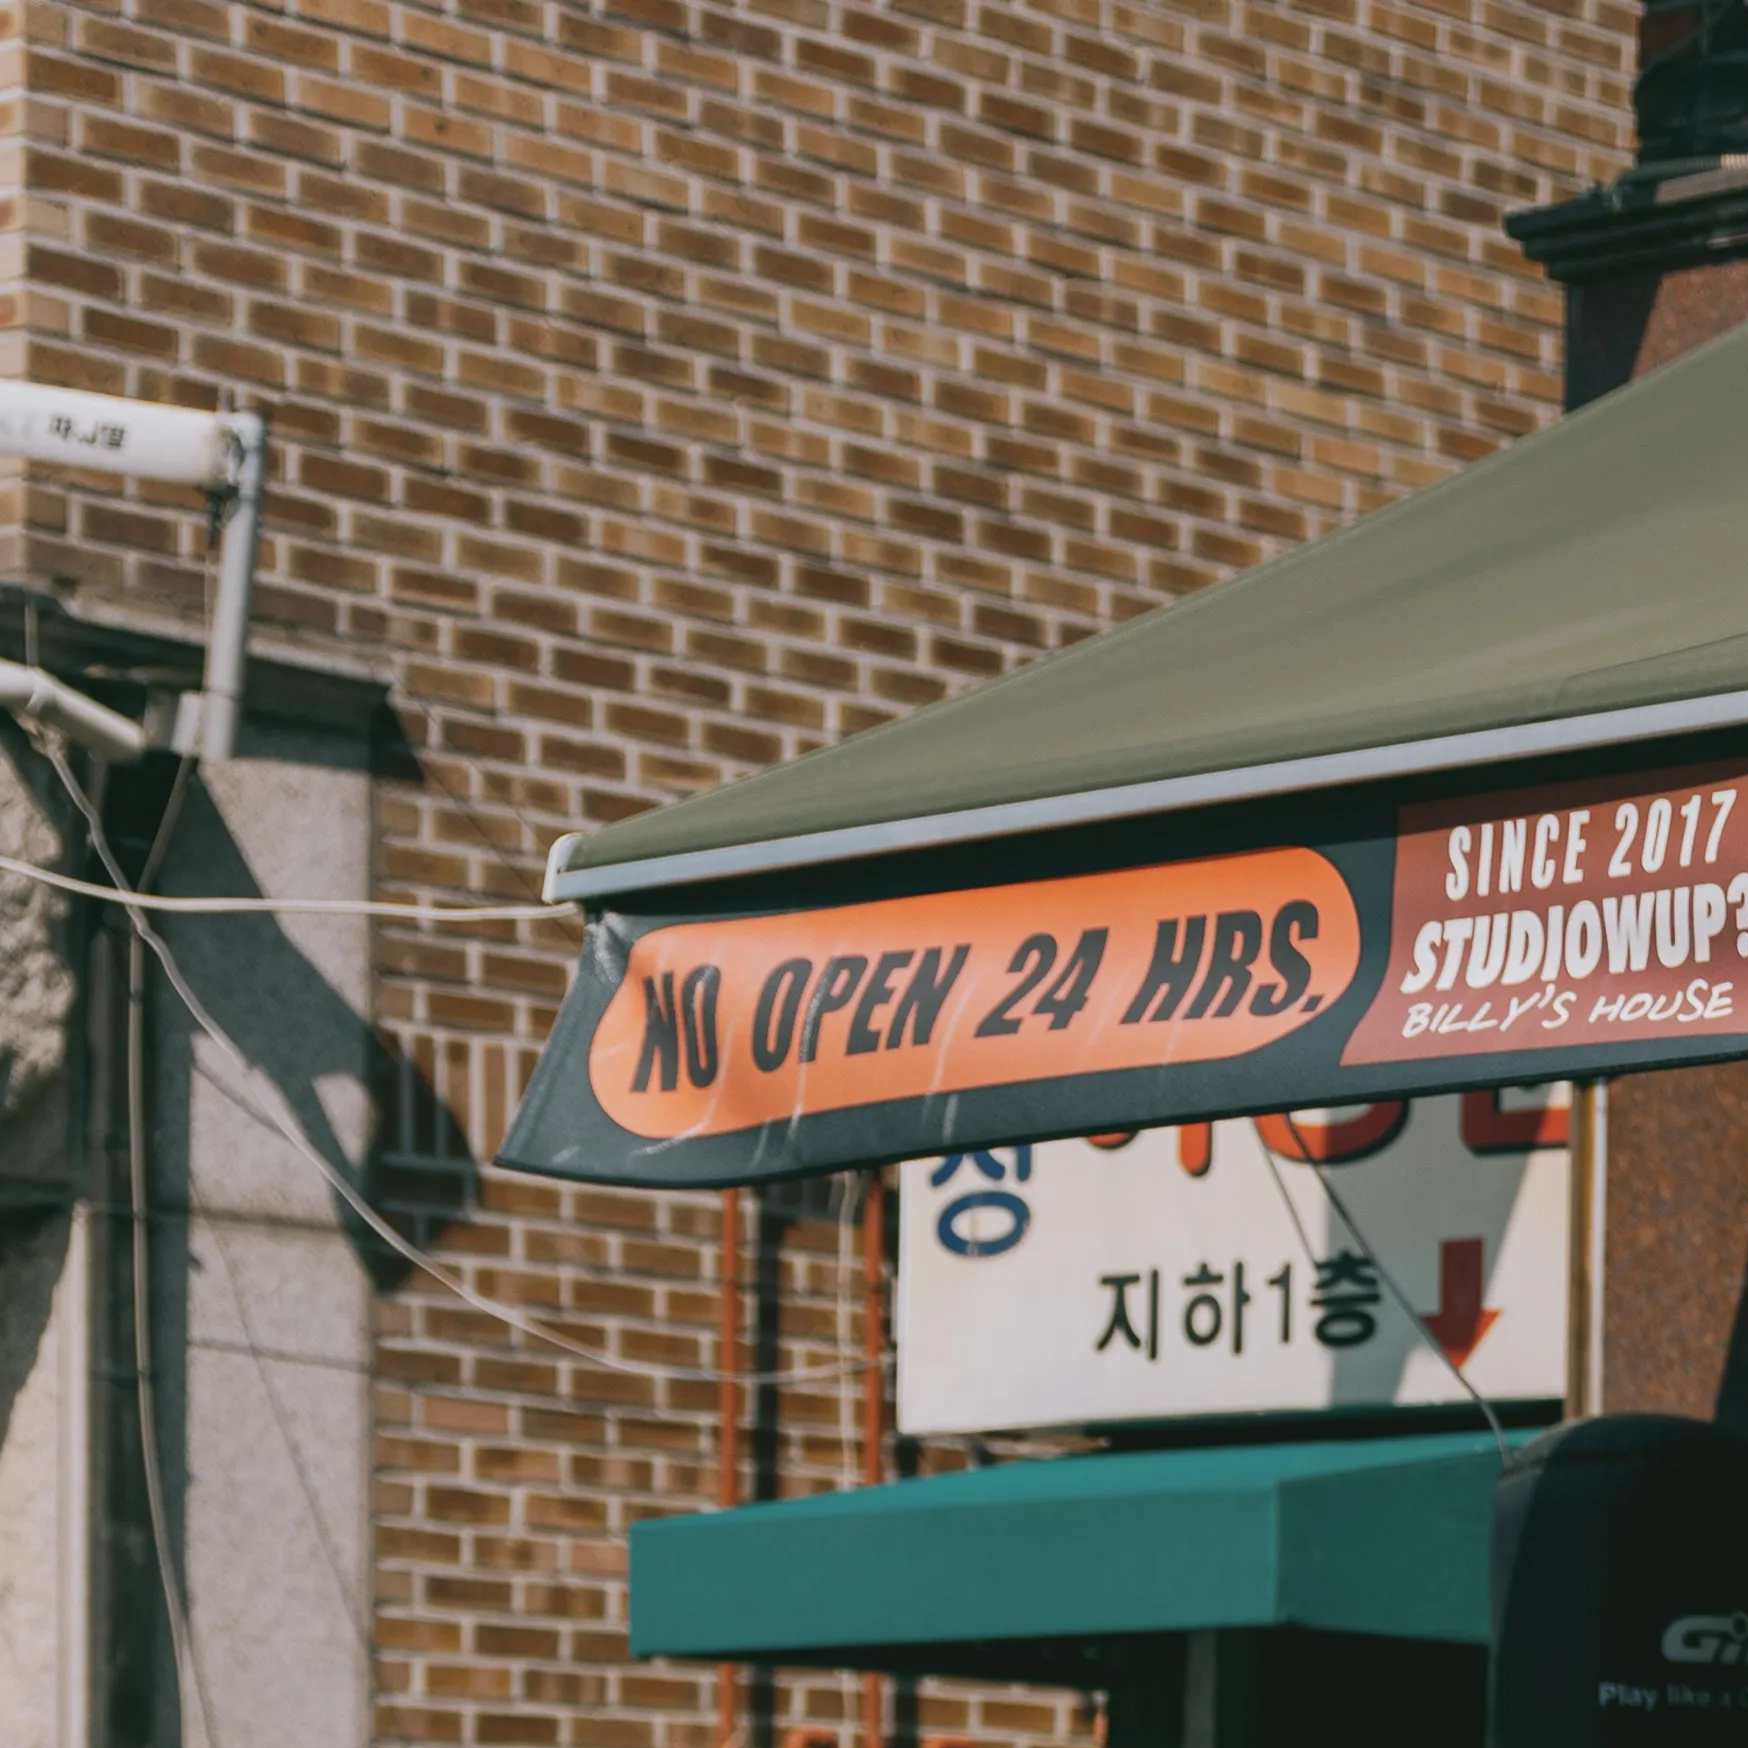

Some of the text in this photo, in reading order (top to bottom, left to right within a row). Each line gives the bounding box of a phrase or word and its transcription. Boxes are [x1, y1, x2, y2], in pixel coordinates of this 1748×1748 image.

[1445, 789, 1737, 901] SINCE 2017
[629, 899, 1325, 1093] NO OPEN 24 HRS.
[1401, 978, 1734, 1038] BILLY'S HOUSE
[1598, 1681, 1659, 1712] Play
